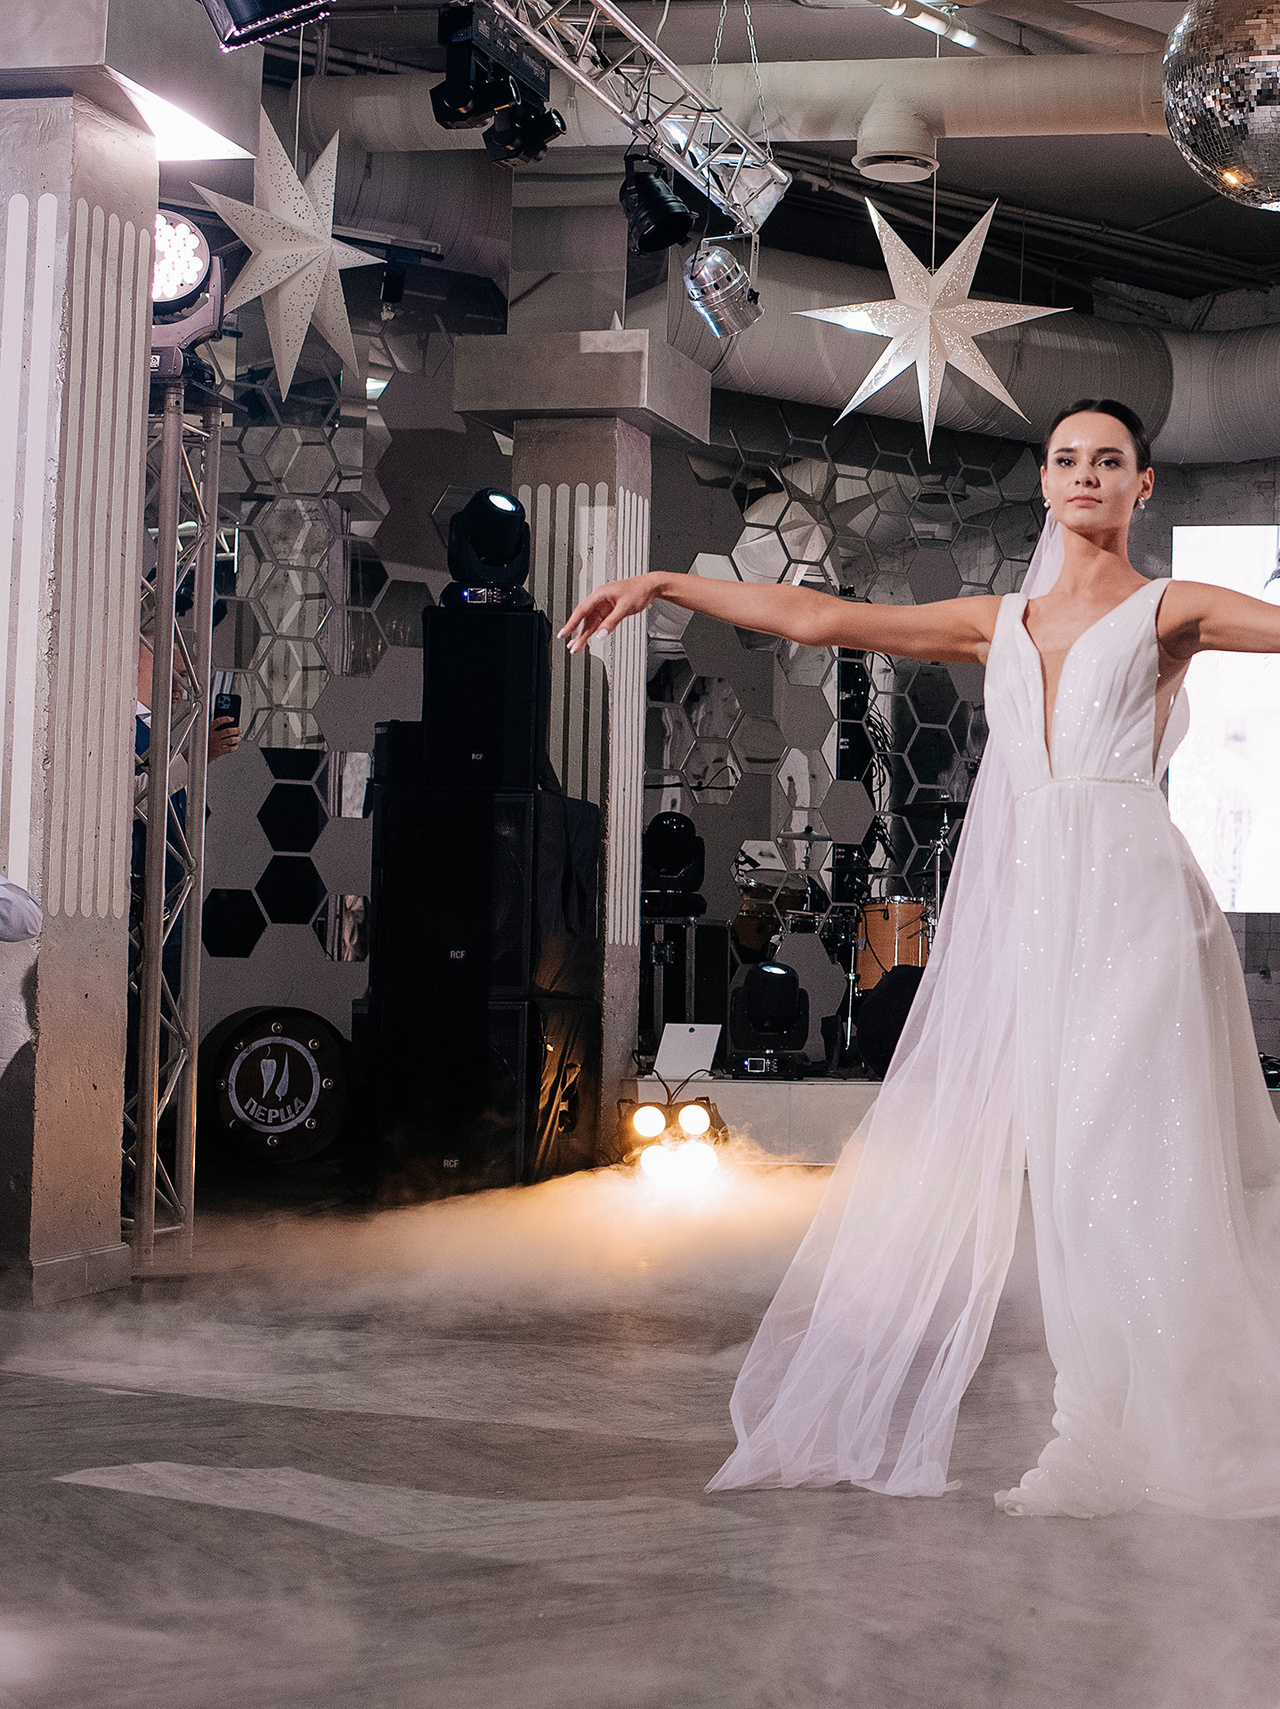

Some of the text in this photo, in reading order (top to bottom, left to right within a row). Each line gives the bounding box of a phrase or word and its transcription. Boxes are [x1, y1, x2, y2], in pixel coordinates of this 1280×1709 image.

[450, 950, 466, 959] RCF
[244, 1097, 306, 1124] ПЕРЦА
[443, 1159, 459, 1168] RCF
